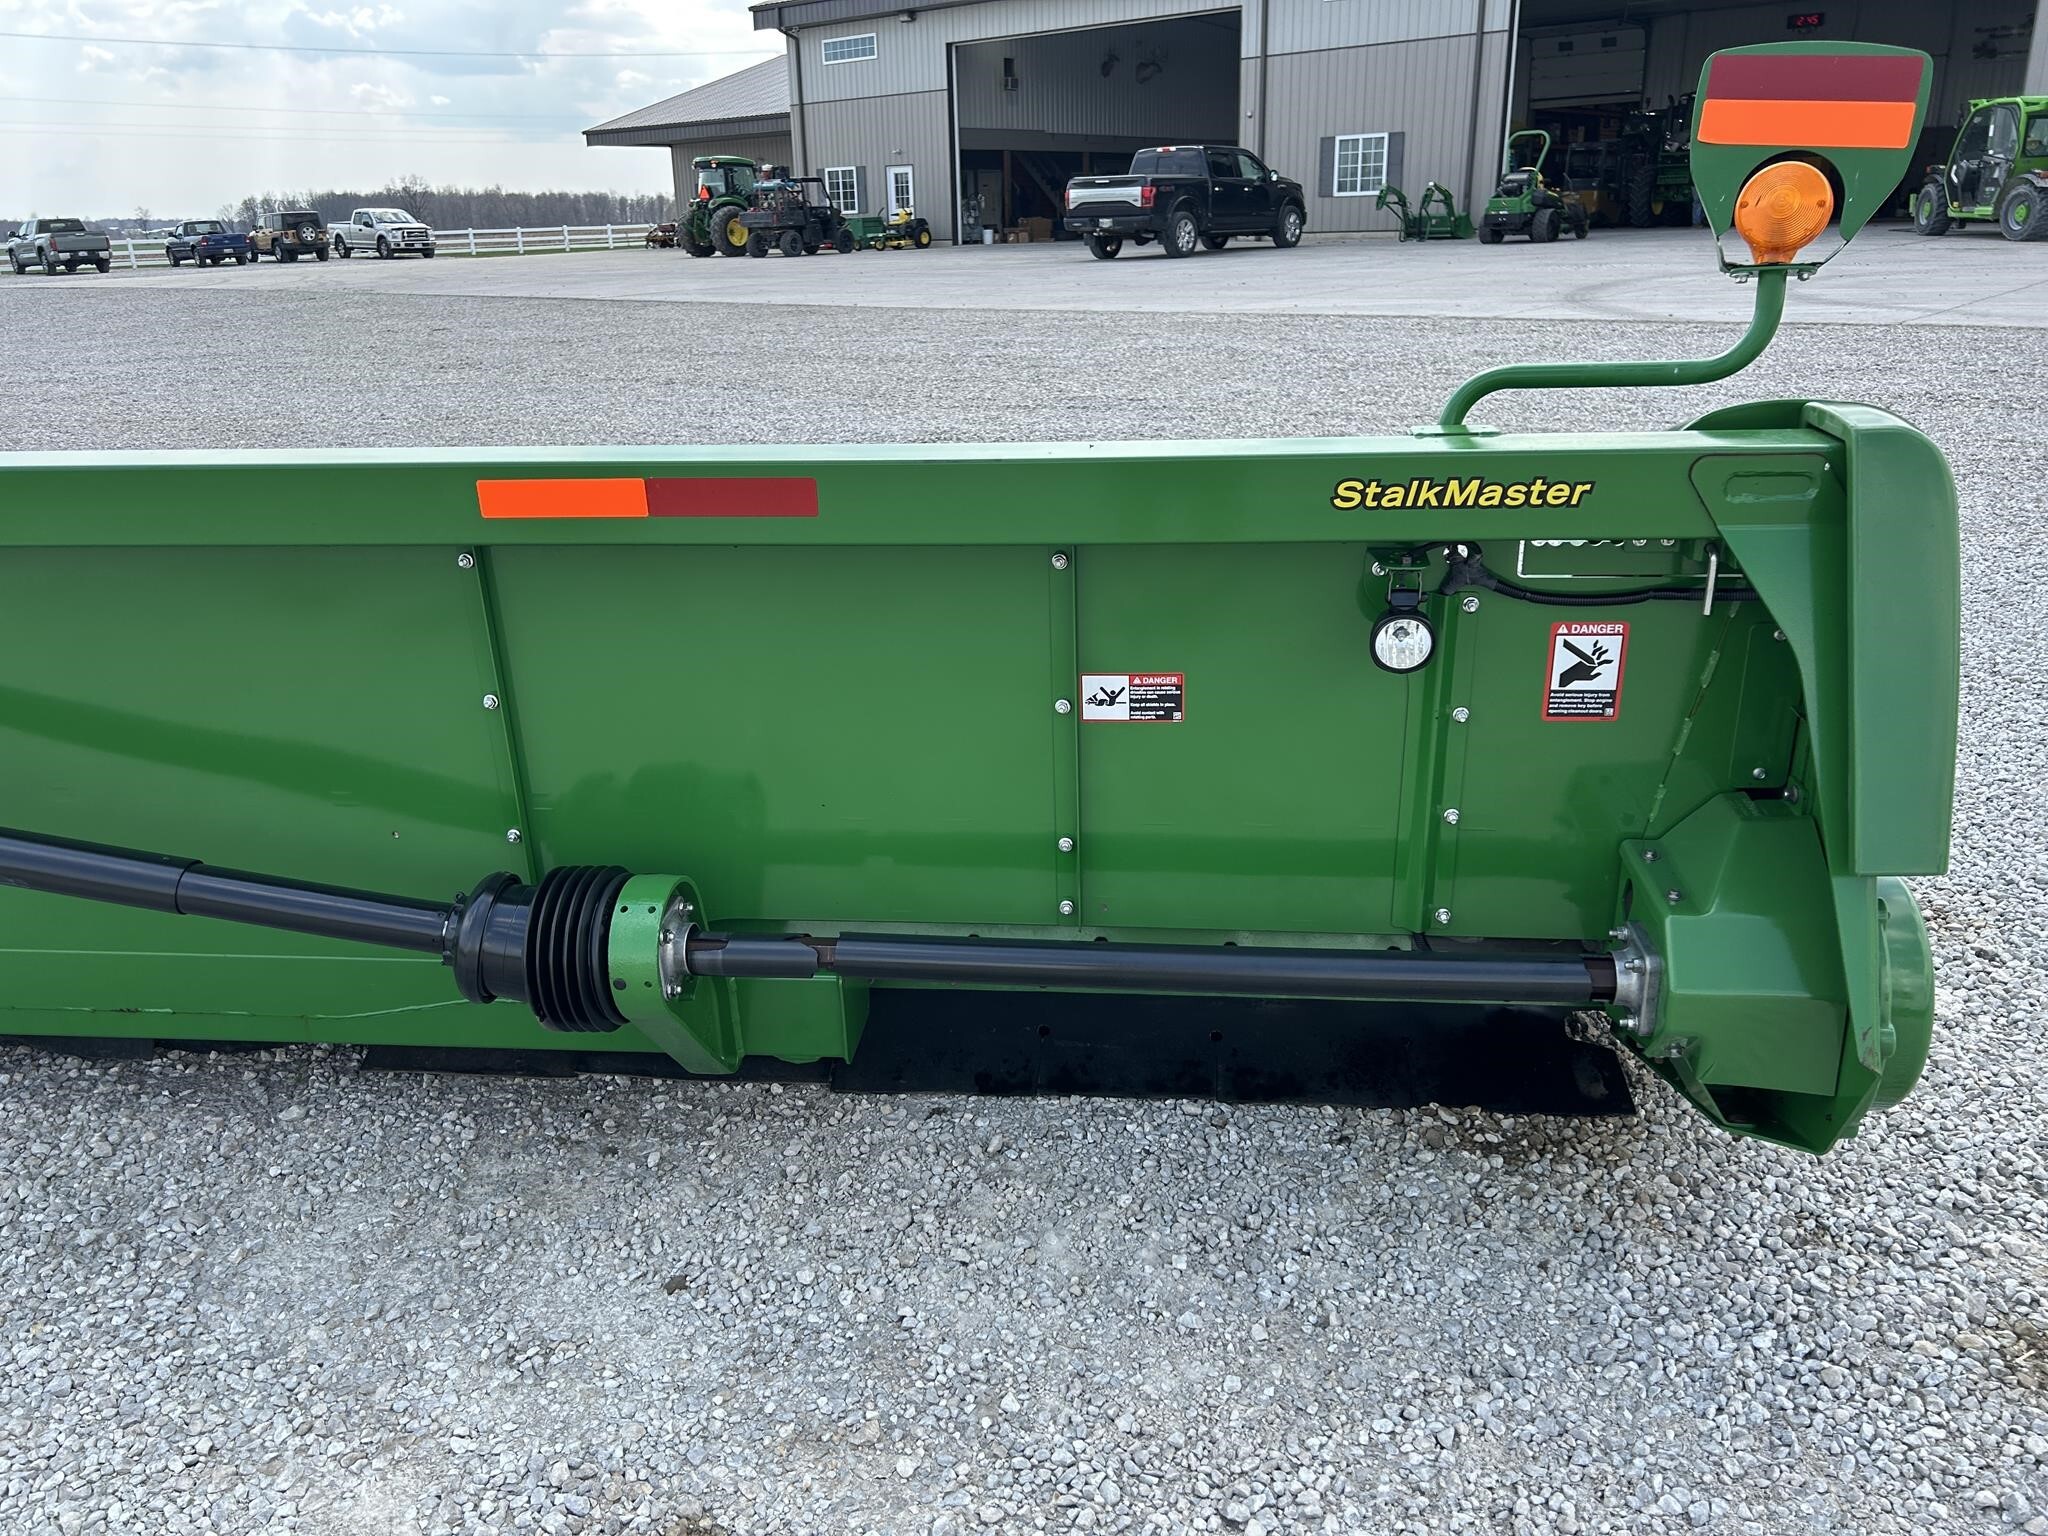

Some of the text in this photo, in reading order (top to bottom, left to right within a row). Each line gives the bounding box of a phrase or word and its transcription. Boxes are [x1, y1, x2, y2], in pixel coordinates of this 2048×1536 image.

[1331, 477, 1594, 509] StalkMaster
[1571, 624, 1624, 634] DANGER
[1143, 676, 1178, 684] DANGER
